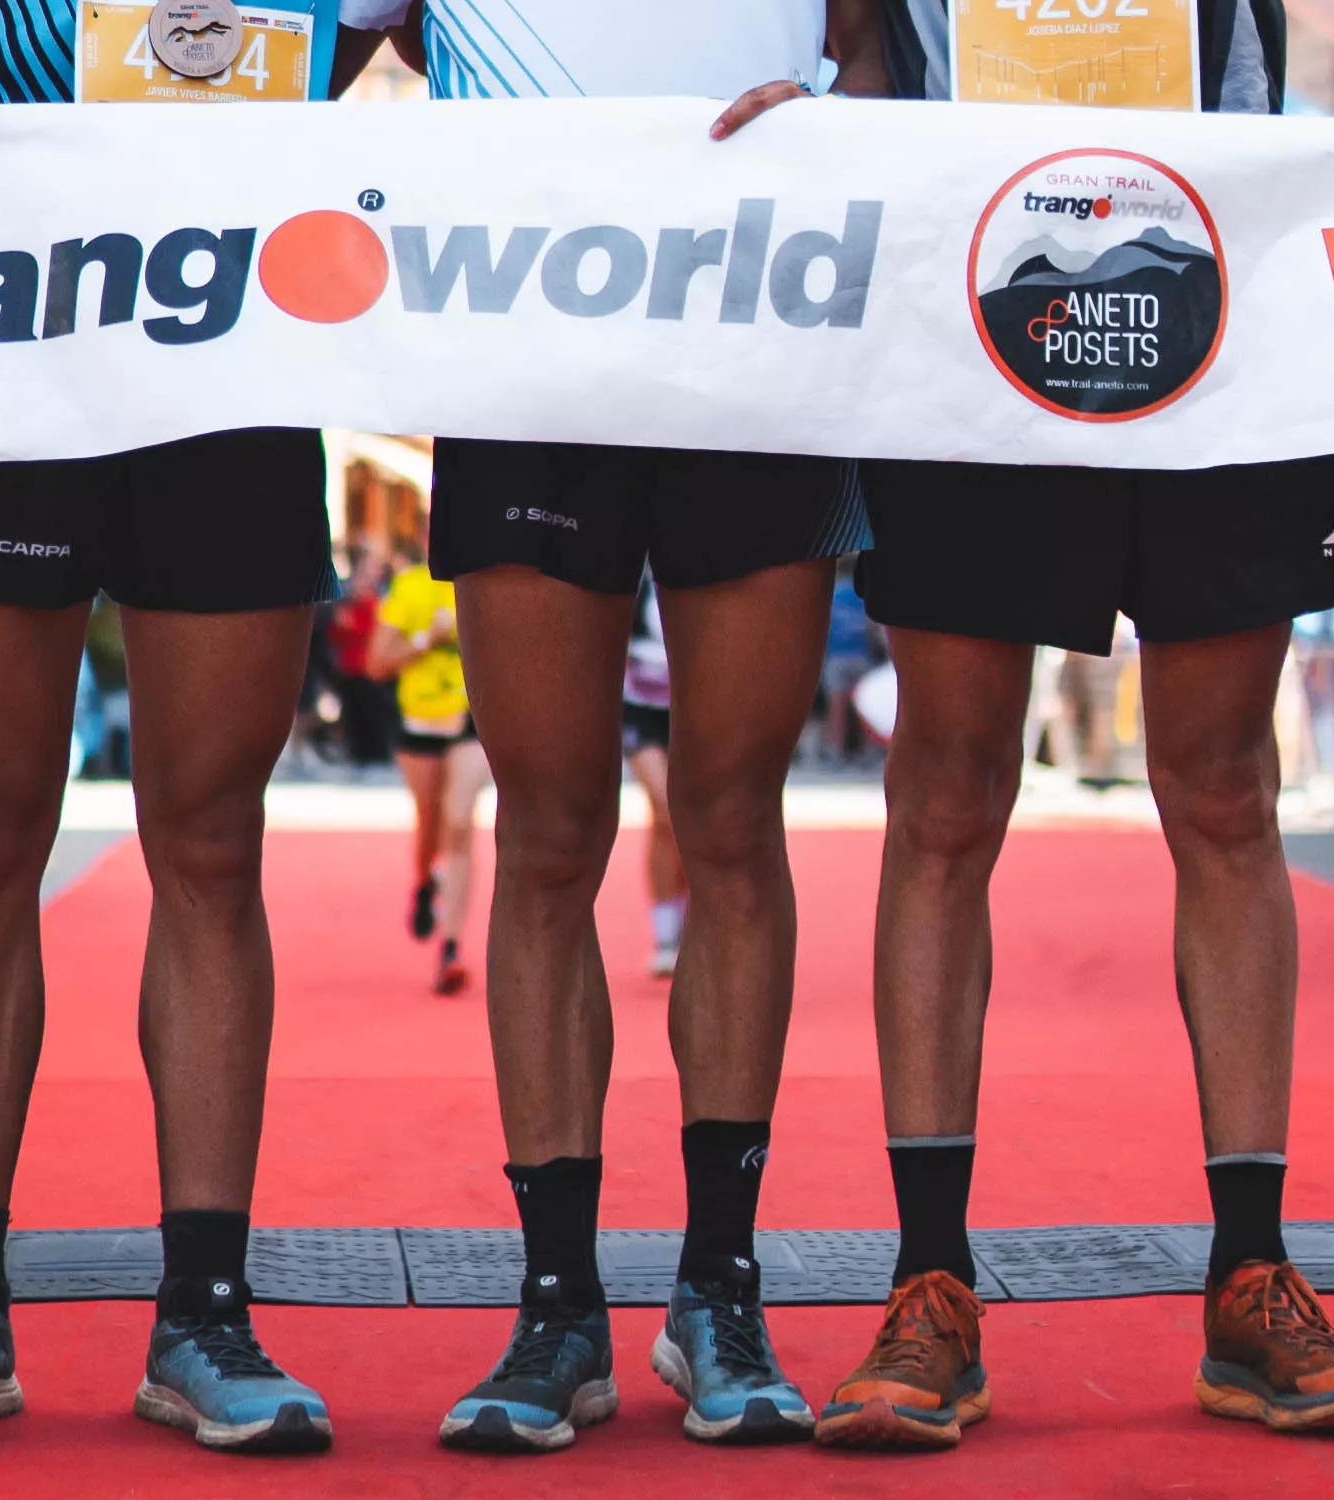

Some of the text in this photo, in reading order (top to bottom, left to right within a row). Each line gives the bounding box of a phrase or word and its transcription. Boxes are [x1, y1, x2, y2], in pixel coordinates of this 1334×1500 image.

[123, 23, 270, 91] 44
[145, 85, 178, 98] JAVIER
[180, 88, 206, 100] VIVES
[1046, 173, 1155, 191] GRAN TRAIL
[1067, 291, 1159, 329] ANETO
[1045, 329, 1159, 368] POSETS
[1045, 377, 1149, 392] www.trail-aneto.com
